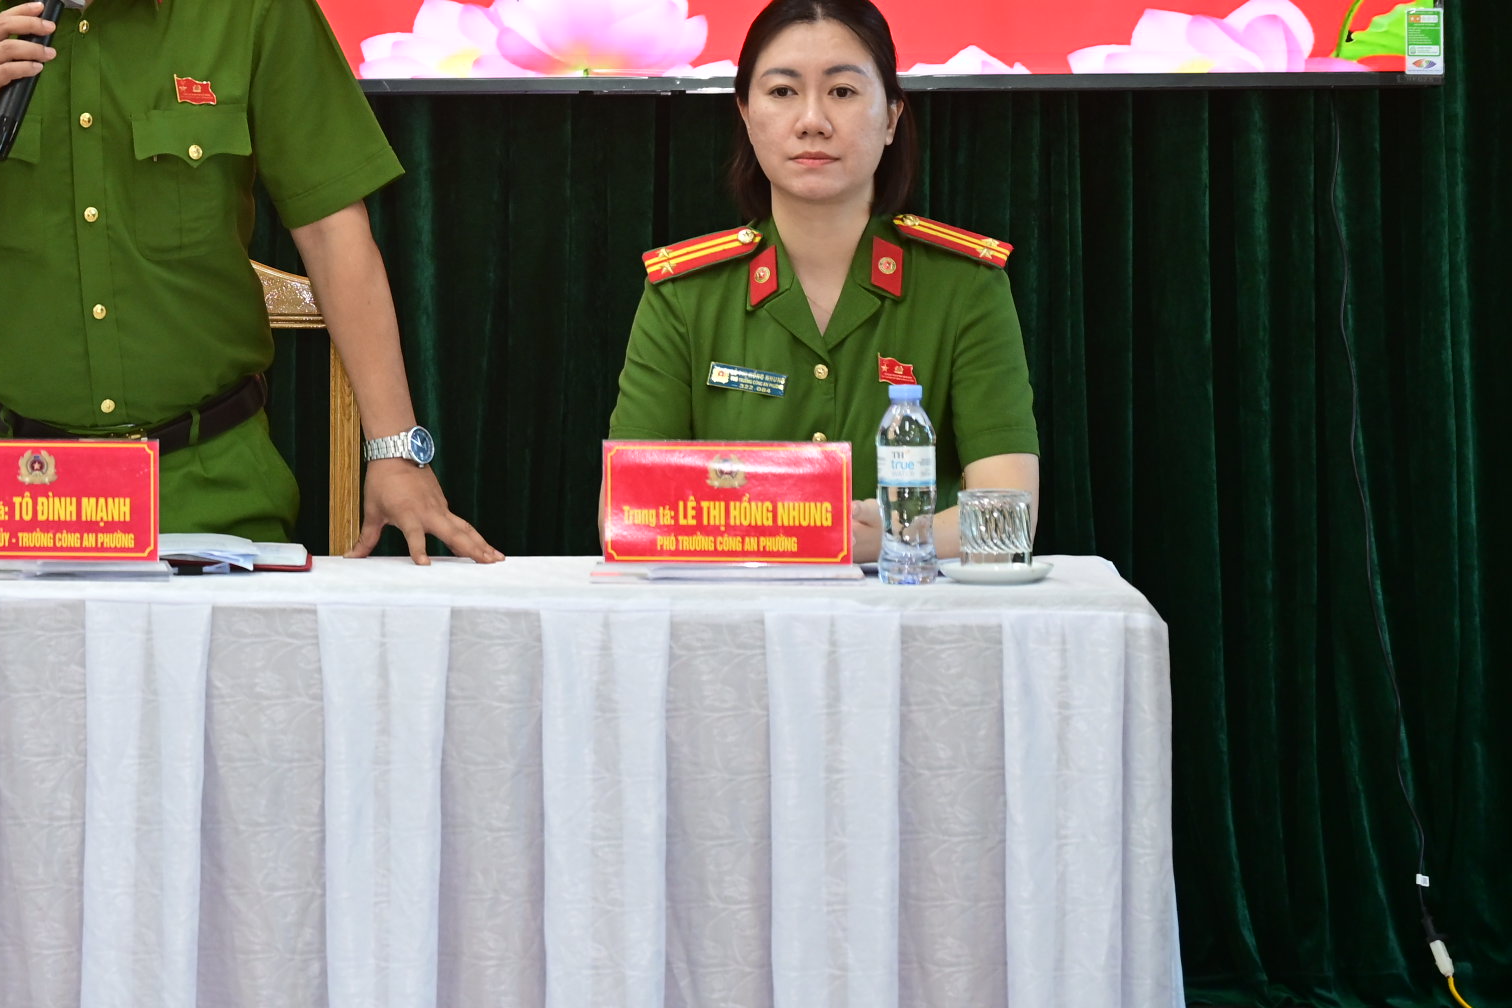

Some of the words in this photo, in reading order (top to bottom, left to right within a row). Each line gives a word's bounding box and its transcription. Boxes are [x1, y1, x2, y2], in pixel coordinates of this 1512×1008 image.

[891, 459, 915, 470] true
[13, 491, 33, 521] TÔ
[37, 491, 77, 522] ĐÌNH
[81, 496, 131, 527] MẠNH
[623, 505, 656, 528] Trung
[659, 505, 675, 525] tá:
[678, 495, 697, 526] LÊ
[701, 501, 726, 532] THỊ
[777, 501, 833, 528] NHUNG
[18, 527, 54, 548] TRƯỞNG
[55, 529, 81, 548] CÔNG
[82, 532, 96, 548] AN
[657, 533, 676, 551] PHÓ
[678, 531, 715, 552] TRƯỞNG
[716, 533, 742, 552] CÔNG
[743, 536, 758, 552] AN
